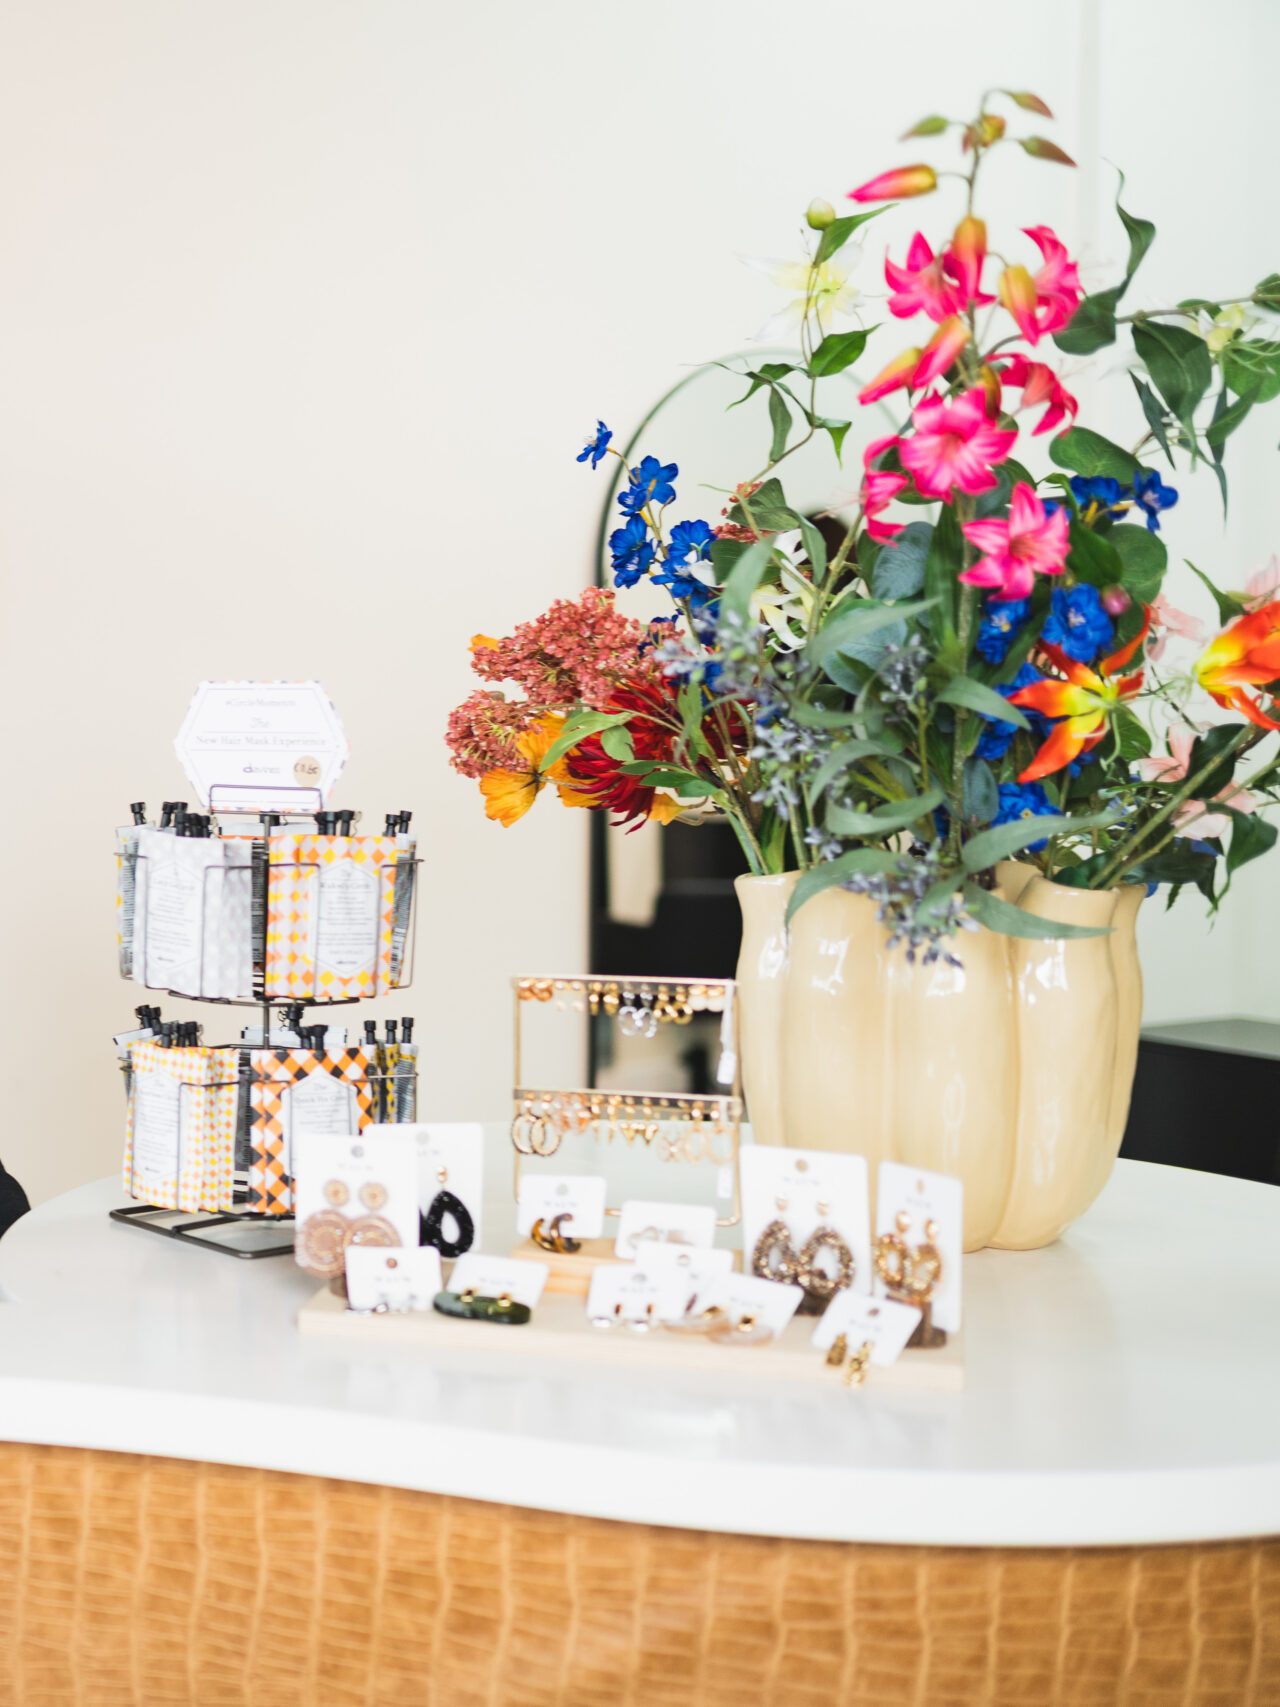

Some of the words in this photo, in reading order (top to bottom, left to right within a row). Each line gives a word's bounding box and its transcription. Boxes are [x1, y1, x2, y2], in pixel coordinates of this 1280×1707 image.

[196, 735, 218, 745] New
[220, 735, 242, 745] Hair
[245, 736, 269, 745] Mask
[272, 736, 326, 748] Experience
